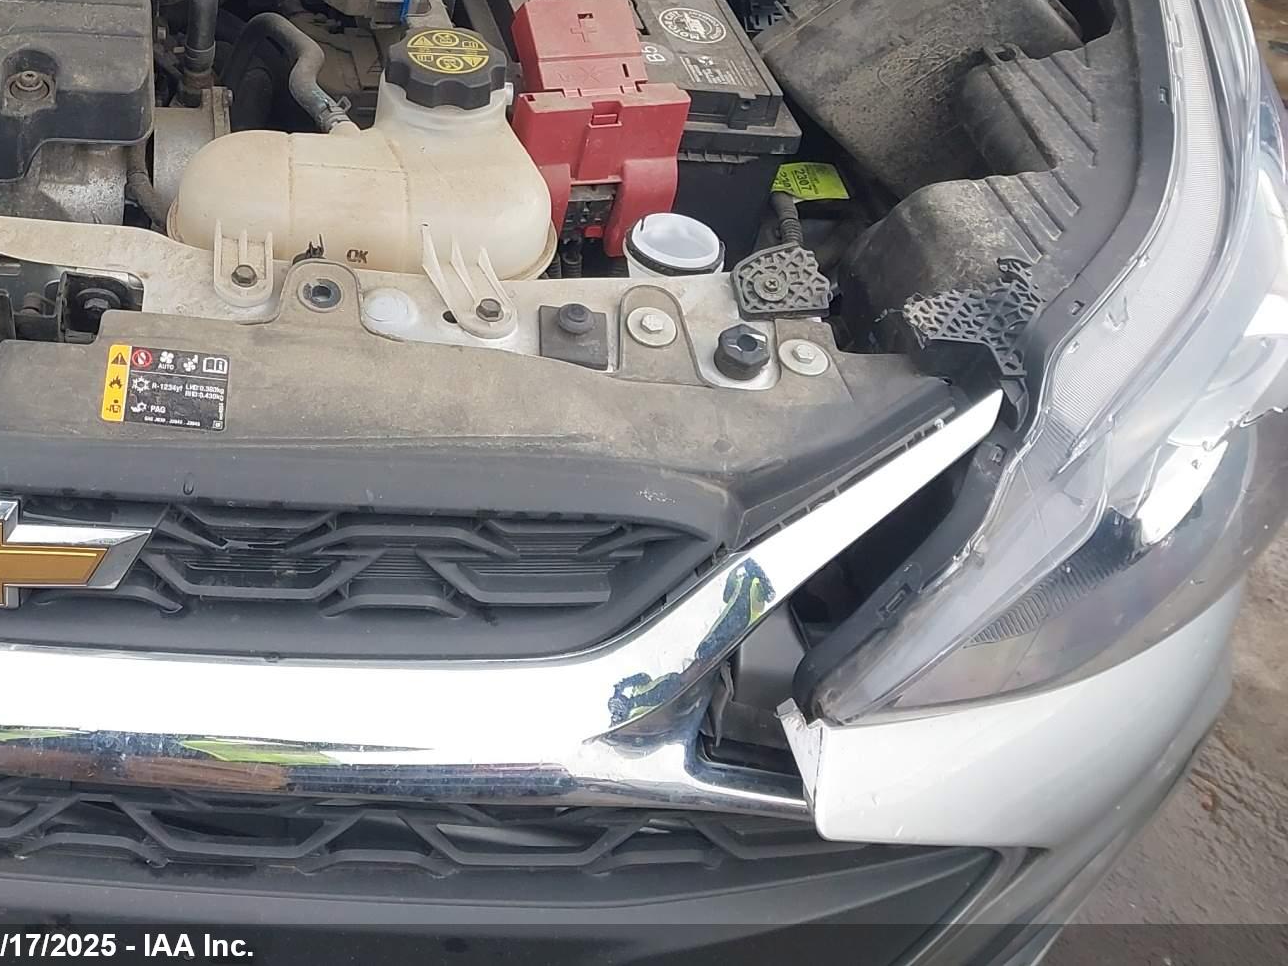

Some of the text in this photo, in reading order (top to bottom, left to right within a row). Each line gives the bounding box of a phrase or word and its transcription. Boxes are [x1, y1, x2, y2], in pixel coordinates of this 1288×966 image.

[794, 168, 812, 191] 2307
[346, 249, 369, 264] OK
[151, 382, 183, 393] R-1234yf
[150, 405, 166, 414] PAG
